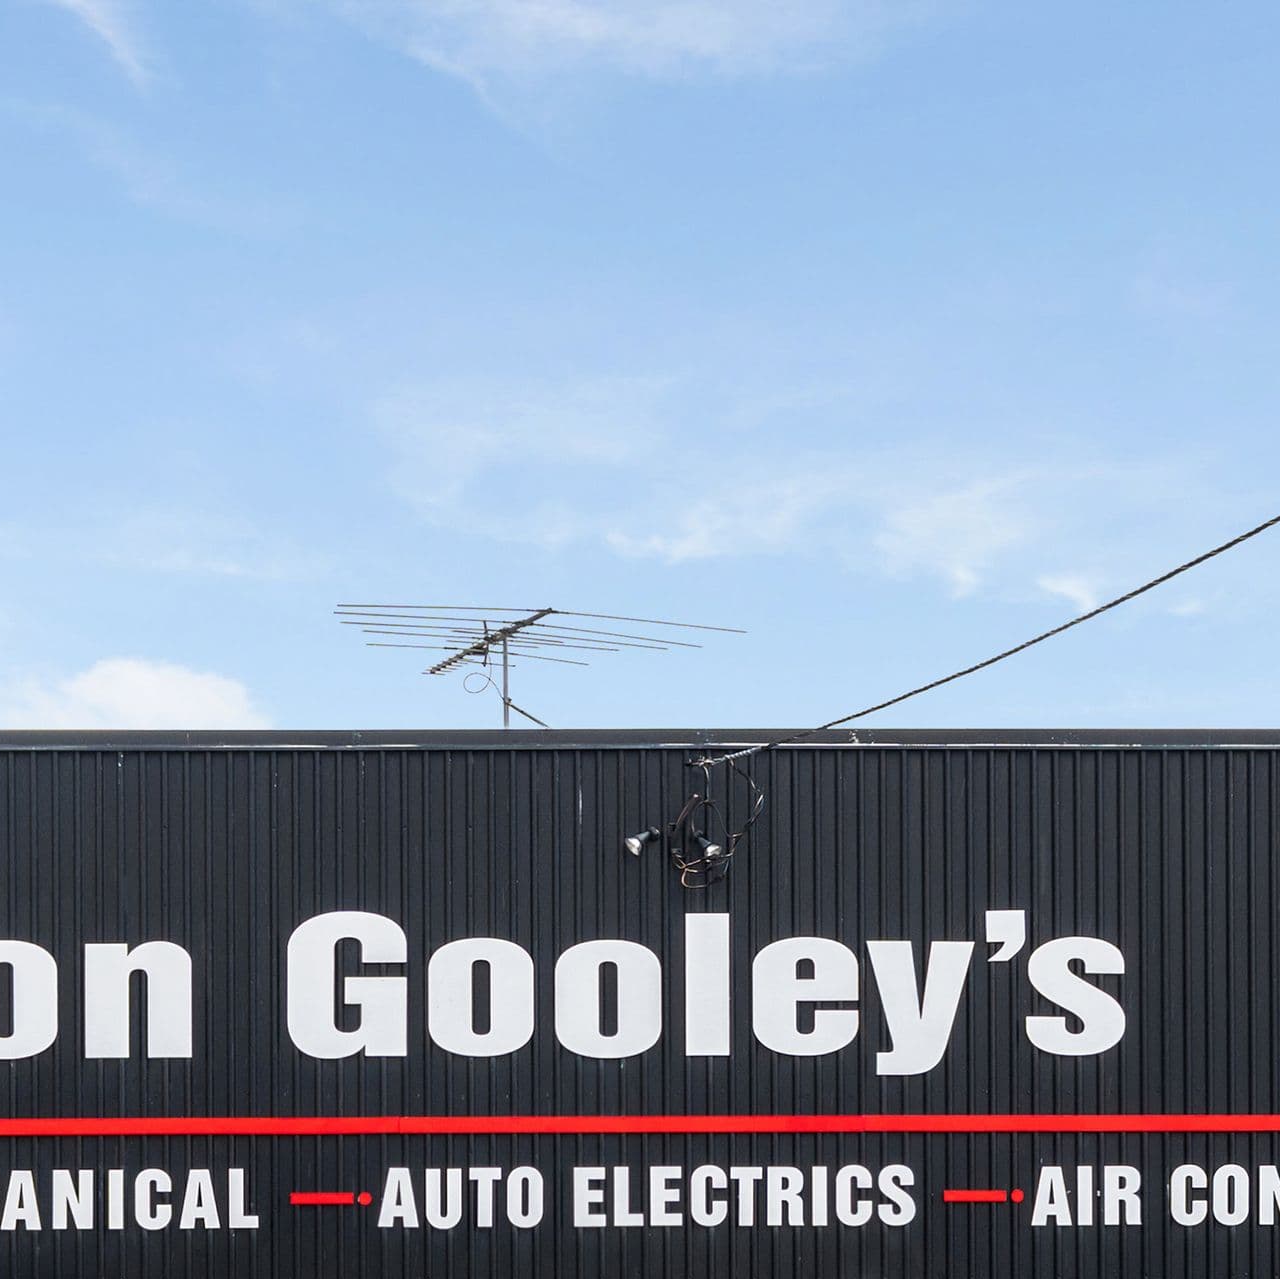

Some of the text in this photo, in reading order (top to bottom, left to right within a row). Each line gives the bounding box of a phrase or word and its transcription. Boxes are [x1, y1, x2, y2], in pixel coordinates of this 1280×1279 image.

[286, 909, 1126, 1076] Gooley's
[377, 1165, 544, 1230] AUTO
[572, 1163, 916, 1228] ELECTRICS
[1031, 1164, 1141, 1227] AIR
